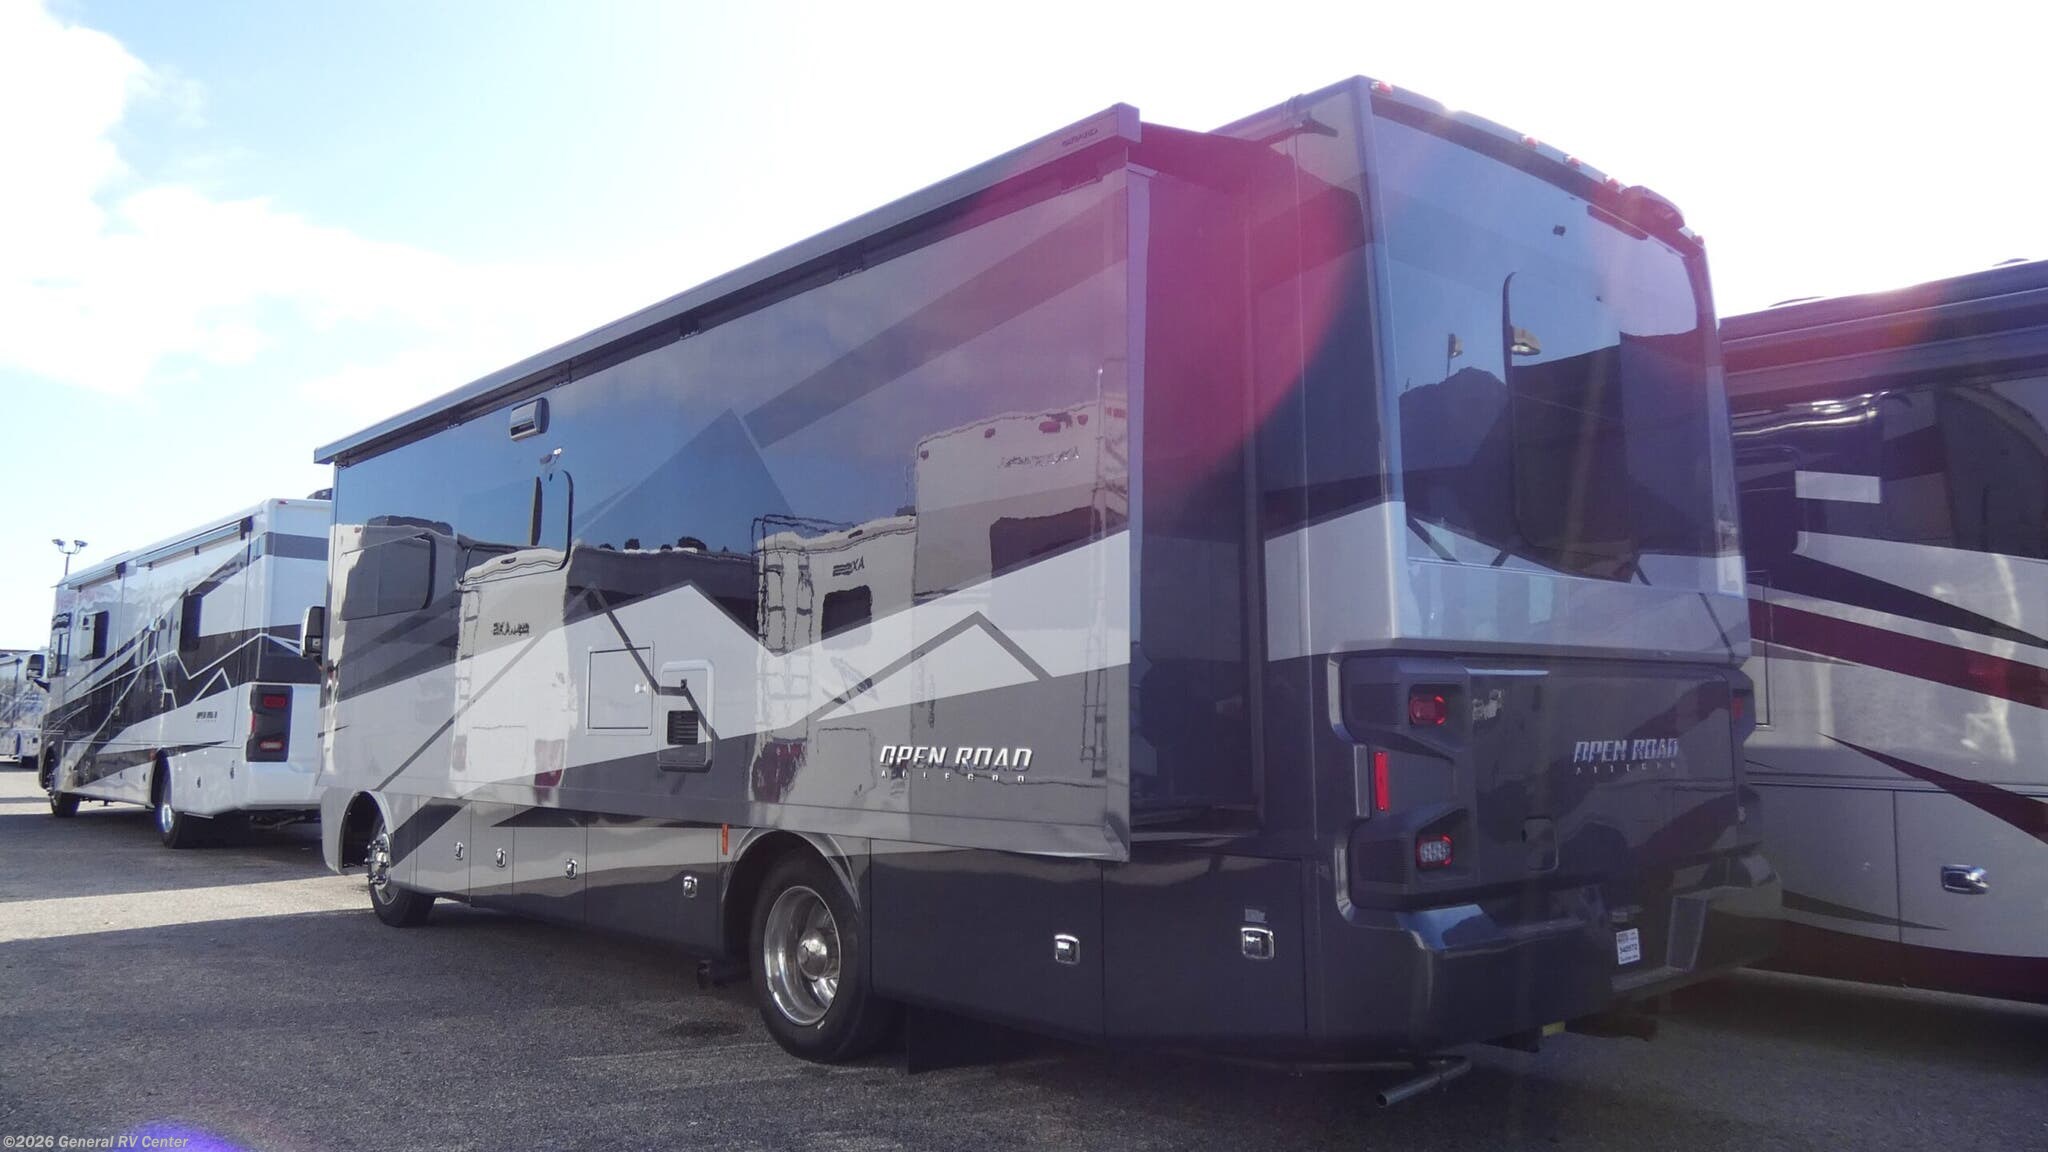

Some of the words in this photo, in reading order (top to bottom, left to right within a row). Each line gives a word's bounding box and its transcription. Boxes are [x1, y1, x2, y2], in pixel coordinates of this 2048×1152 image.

[880, 745, 948, 767] OPEN
[955, 747, 1033, 771] ROAD
[1574, 740, 1627, 762] OPEN
[1632, 738, 1679, 761] ROAD
[880, 770, 1025, 783] ALLEGRO
